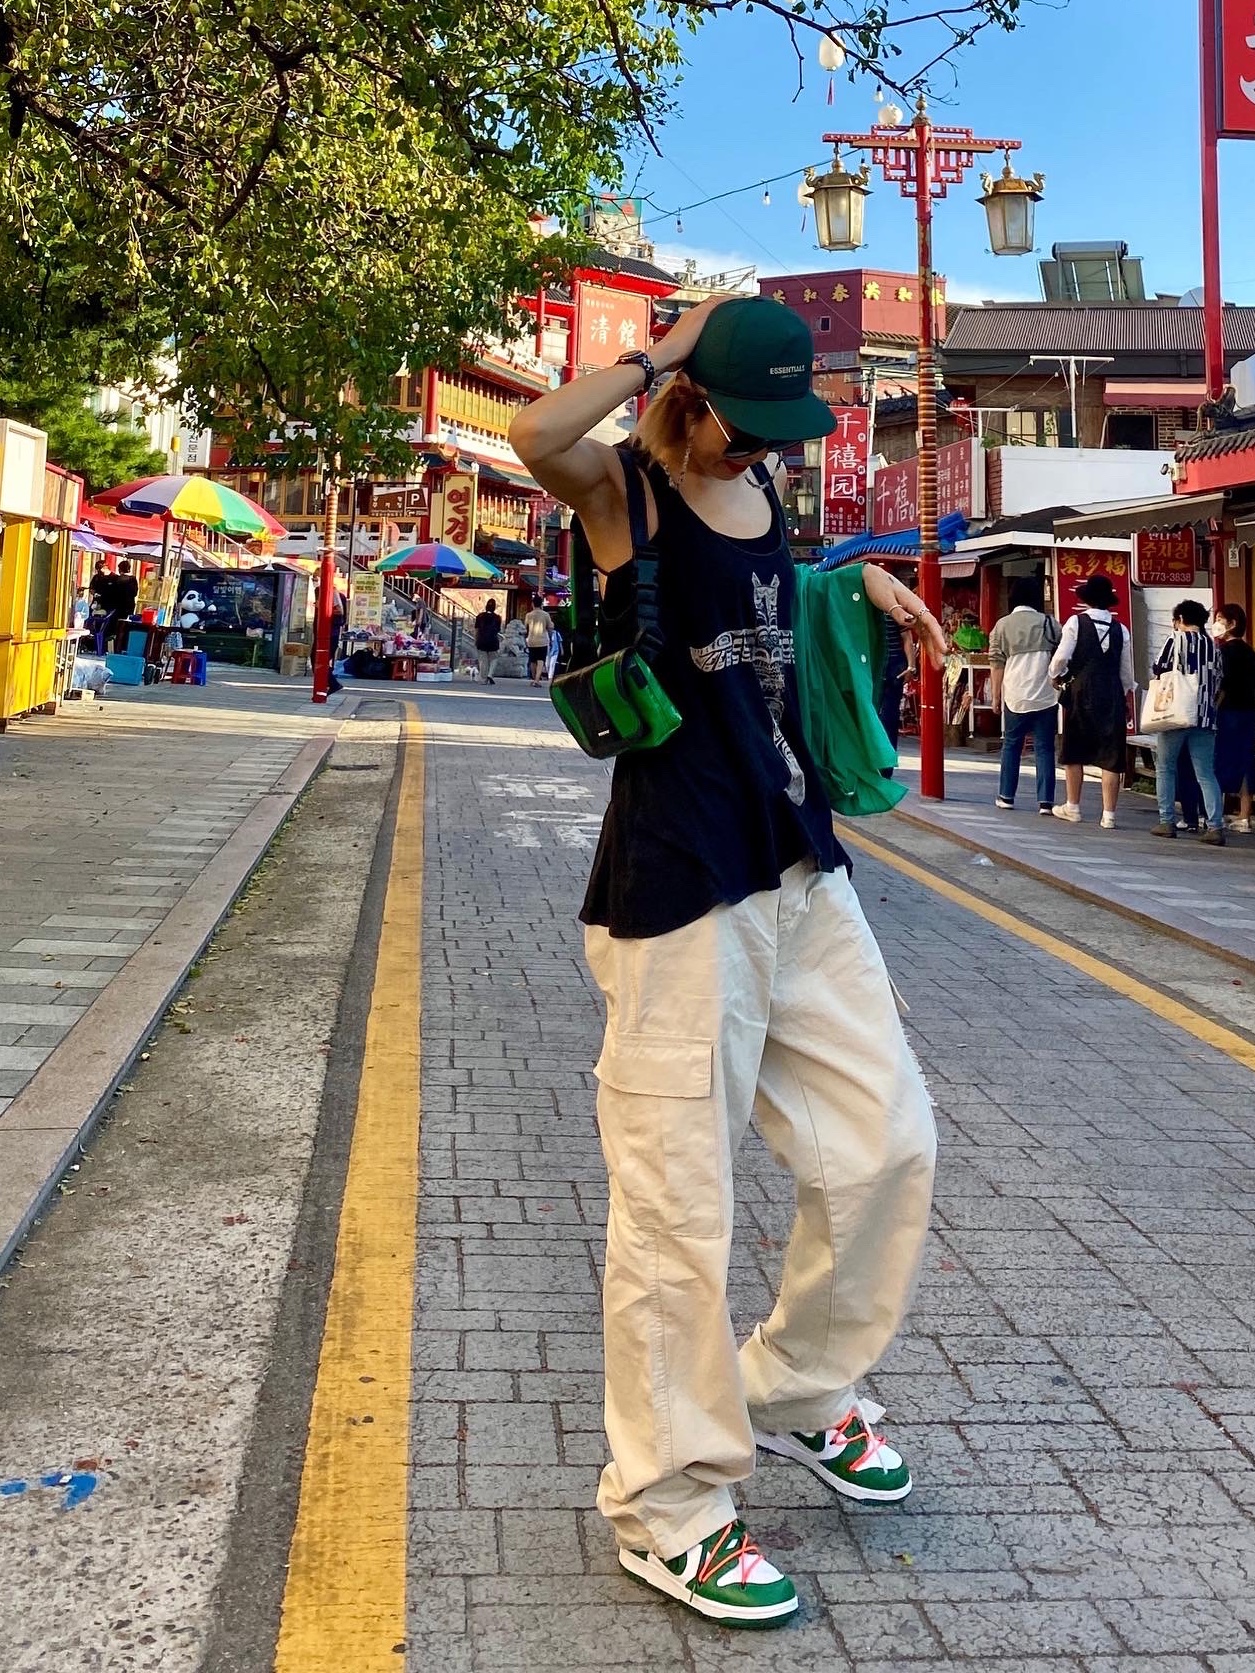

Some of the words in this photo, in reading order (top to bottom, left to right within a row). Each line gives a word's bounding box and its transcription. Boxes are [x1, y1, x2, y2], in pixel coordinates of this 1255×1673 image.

[828, 412, 861, 501] 千禧园
[411, 493, 420, 506] P
[445, 486, 471, 545] 연경
[877, 467, 920, 526] 千禧
